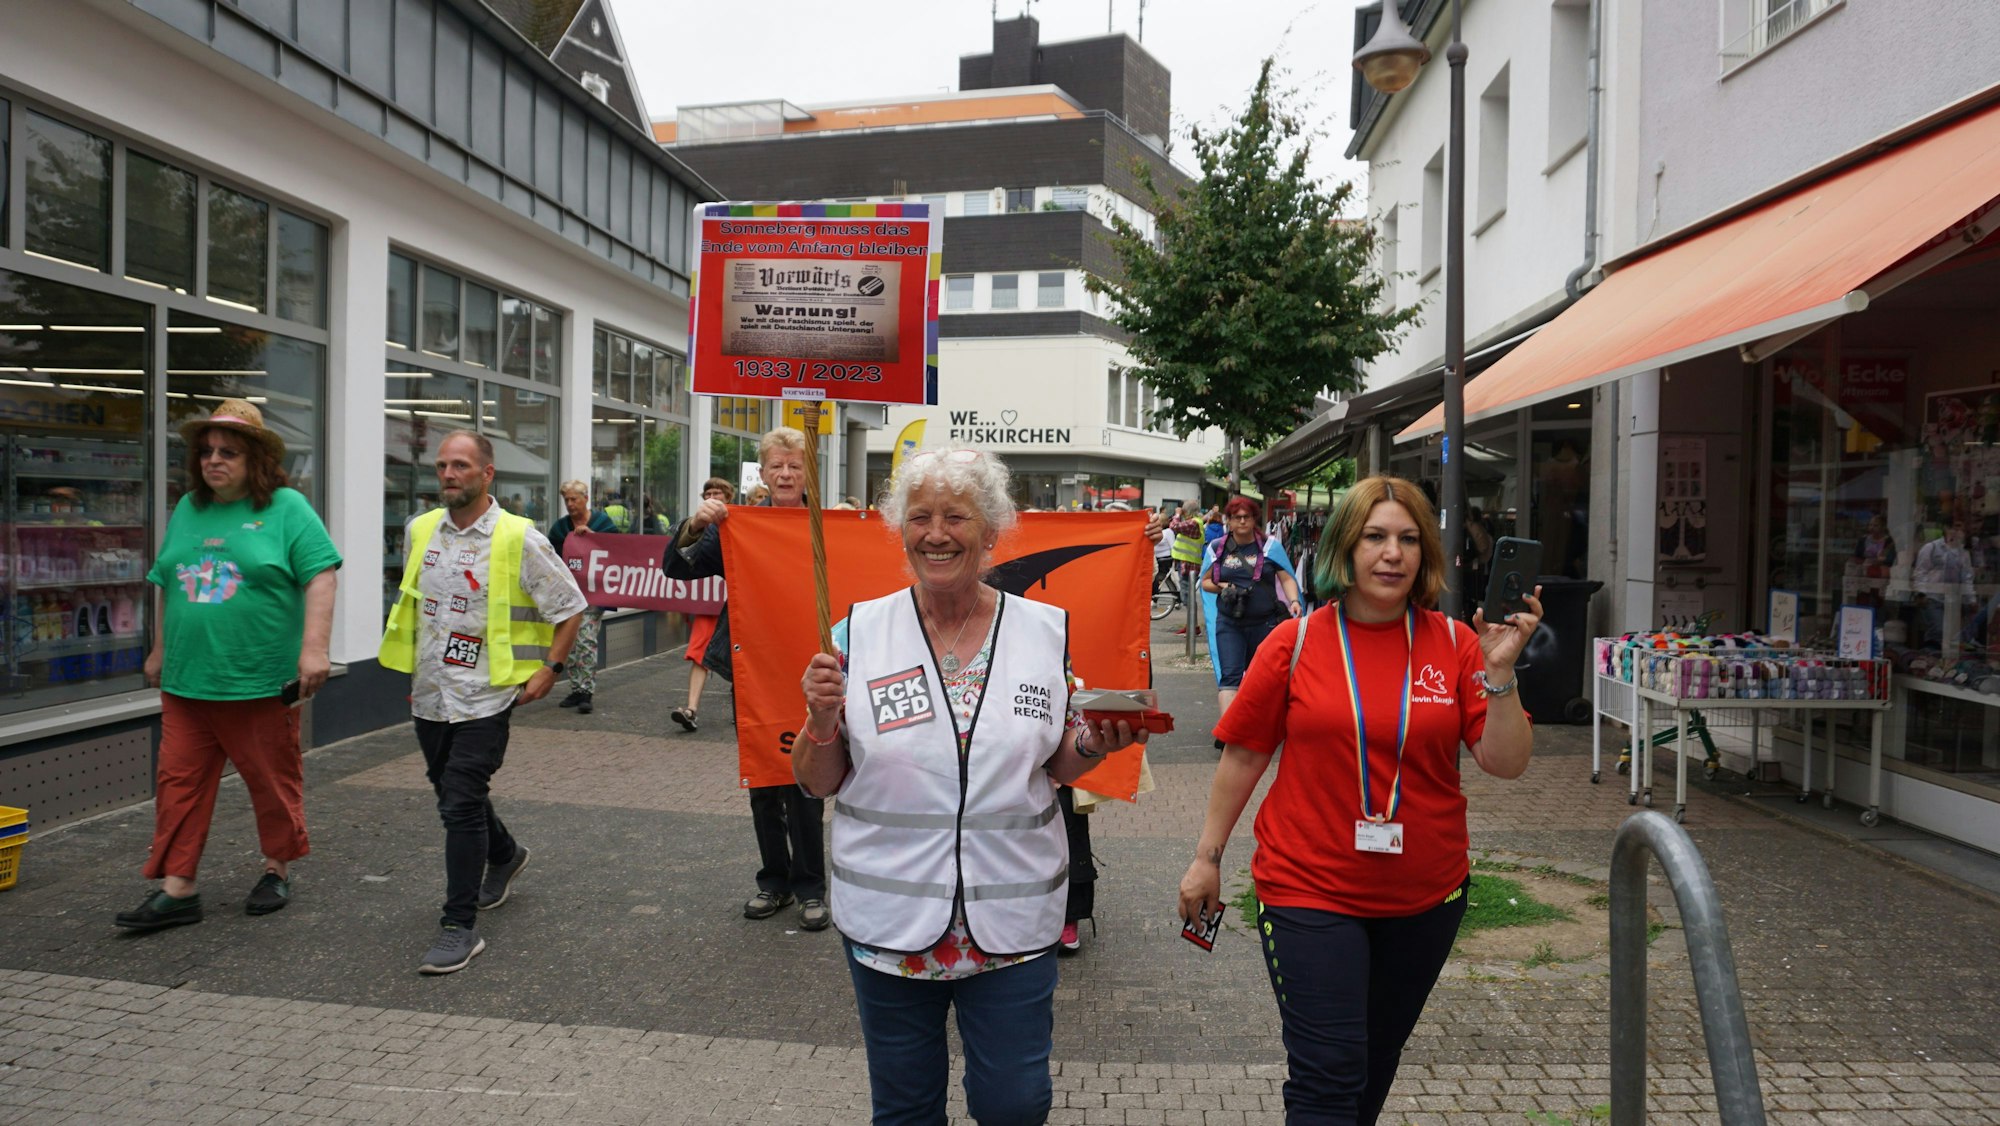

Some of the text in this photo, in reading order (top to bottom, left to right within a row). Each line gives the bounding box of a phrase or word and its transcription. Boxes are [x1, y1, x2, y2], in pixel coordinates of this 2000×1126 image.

[720, 222, 910, 238] Sonneberg muss das
[701, 240, 928, 256] Ende vom Anfang bleiben
[758, 266, 852, 288] Vorwärts
[755, 304, 857, 318] Warnung!
[828, 326, 874, 334] Untergang!
[734, 360, 883, 382] 1933 / 2023
[783, 388, 825, 397] vorwärts
[950, 410, 996, 426] WE...
[950, 428, 1071, 444] EUSKIRCHEN
[449, 638, 480, 653] FCK
[446, 648, 476, 662] AFD
[871, 674, 926, 706] FCK
[1019, 683, 1051, 699] OMAS
[878, 694, 930, 724] AFD
[1014, 695, 1052, 712] GEGEN
[1014, 706, 1054, 726] RECHTS
